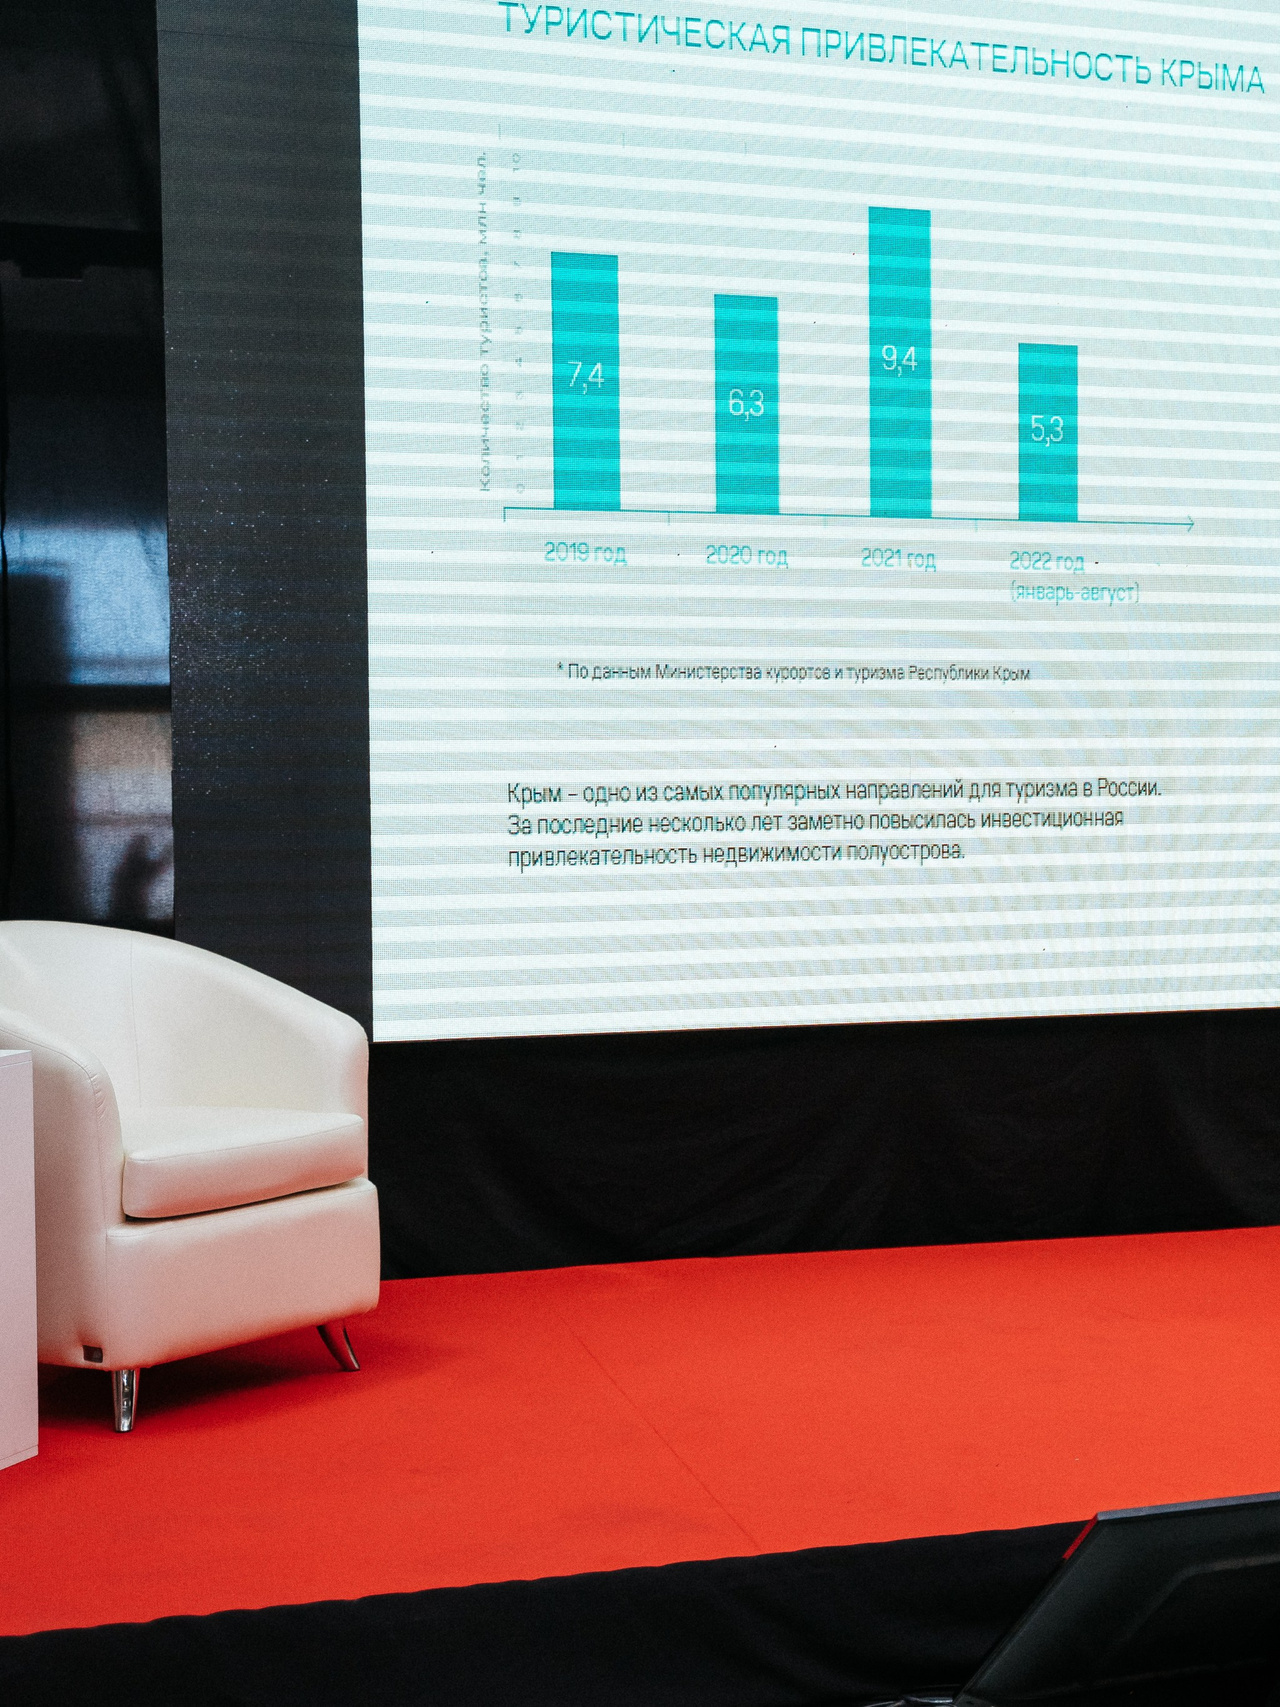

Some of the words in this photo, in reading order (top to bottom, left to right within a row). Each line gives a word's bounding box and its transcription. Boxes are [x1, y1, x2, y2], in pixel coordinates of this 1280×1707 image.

[498, 1, 791, 56] ТУРИСТИЧЕСКАЯ
[801, 27, 1151, 85] ПРИВЛЕКАТЕЛЬНОСТЬ
[1161, 58, 1265, 94] КРЫМА
[881, 344, 918, 377] 9,4
[567, 361, 605, 395] 7,4
[728, 388, 765, 422] 6,3
[1030, 415, 1064, 447] 5,3
[544, 541, 590, 562] 2019
[593, 545, 628, 567] год
[705, 544, 752, 565] 2020
[757, 548, 789, 569] год
[861, 547, 902, 568] 2021
[906, 551, 937, 572] год
[1010, 550, 1052, 571] 2022
[1055, 554, 1086, 575] год
[1011, 579, 1140, 607] (январь-август)
[568, 663, 588, 680] По
[592, 664, 652, 682] данным
[655, 663, 762, 683] Министерства
[766, 664, 831, 684] курортов
[835, 666, 844, 680] и
[846, 665, 905, 684] туризма
[908, 663, 989, 684] Республики
[993, 664, 1031, 684] Крым
[508, 783, 561, 809] Крым
[583, 785, 631, 806] одно
[636, 784, 658, 802] из
[663, 783, 723, 802] самых
[729, 782, 840, 807] популярных
[846, 779, 964, 805] направлений
[968, 781, 1001, 803] для
[1006, 780, 1078, 804] туризма
[1083, 781, 1093, 798] в
[1098, 778, 1162, 798] России.
[508, 814, 531, 835] За
[537, 815, 643, 839] последние
[650, 815, 745, 833] несколько
[751, 814, 782, 832] лет
[787, 812, 864, 832] заметно
[870, 811, 975, 830] повысилась
[981, 810, 1124, 831] инвестиционная
[508, 847, 697, 874] привлекательность
[703, 844, 842, 868] недвижимости
[847, 842, 965, 867] полуострова.
